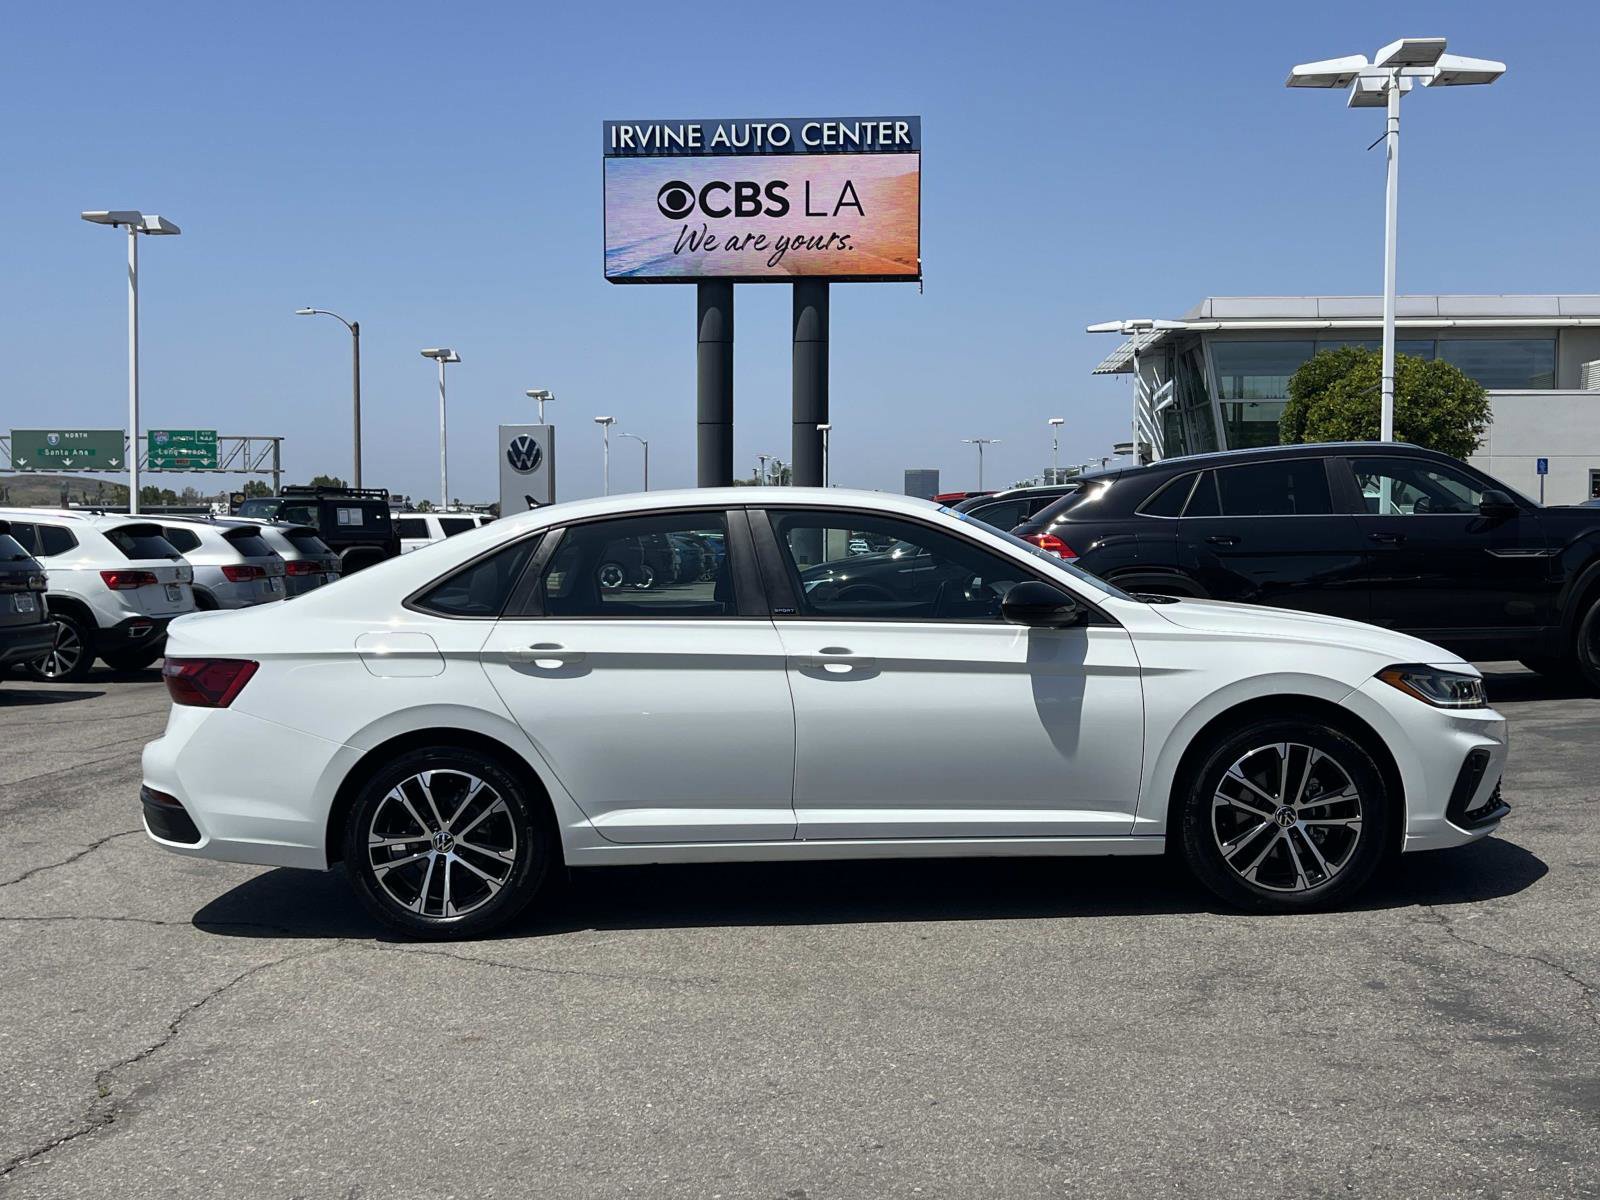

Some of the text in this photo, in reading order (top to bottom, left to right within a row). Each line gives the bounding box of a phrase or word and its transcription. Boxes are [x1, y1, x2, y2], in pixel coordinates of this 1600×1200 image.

[611, 121, 911, 148] IRVINE AUTO CENTER
[699, 180, 866, 219] CBS LA
[673, 222, 854, 268] We are yours.
[44, 448, 69, 456] Santa
